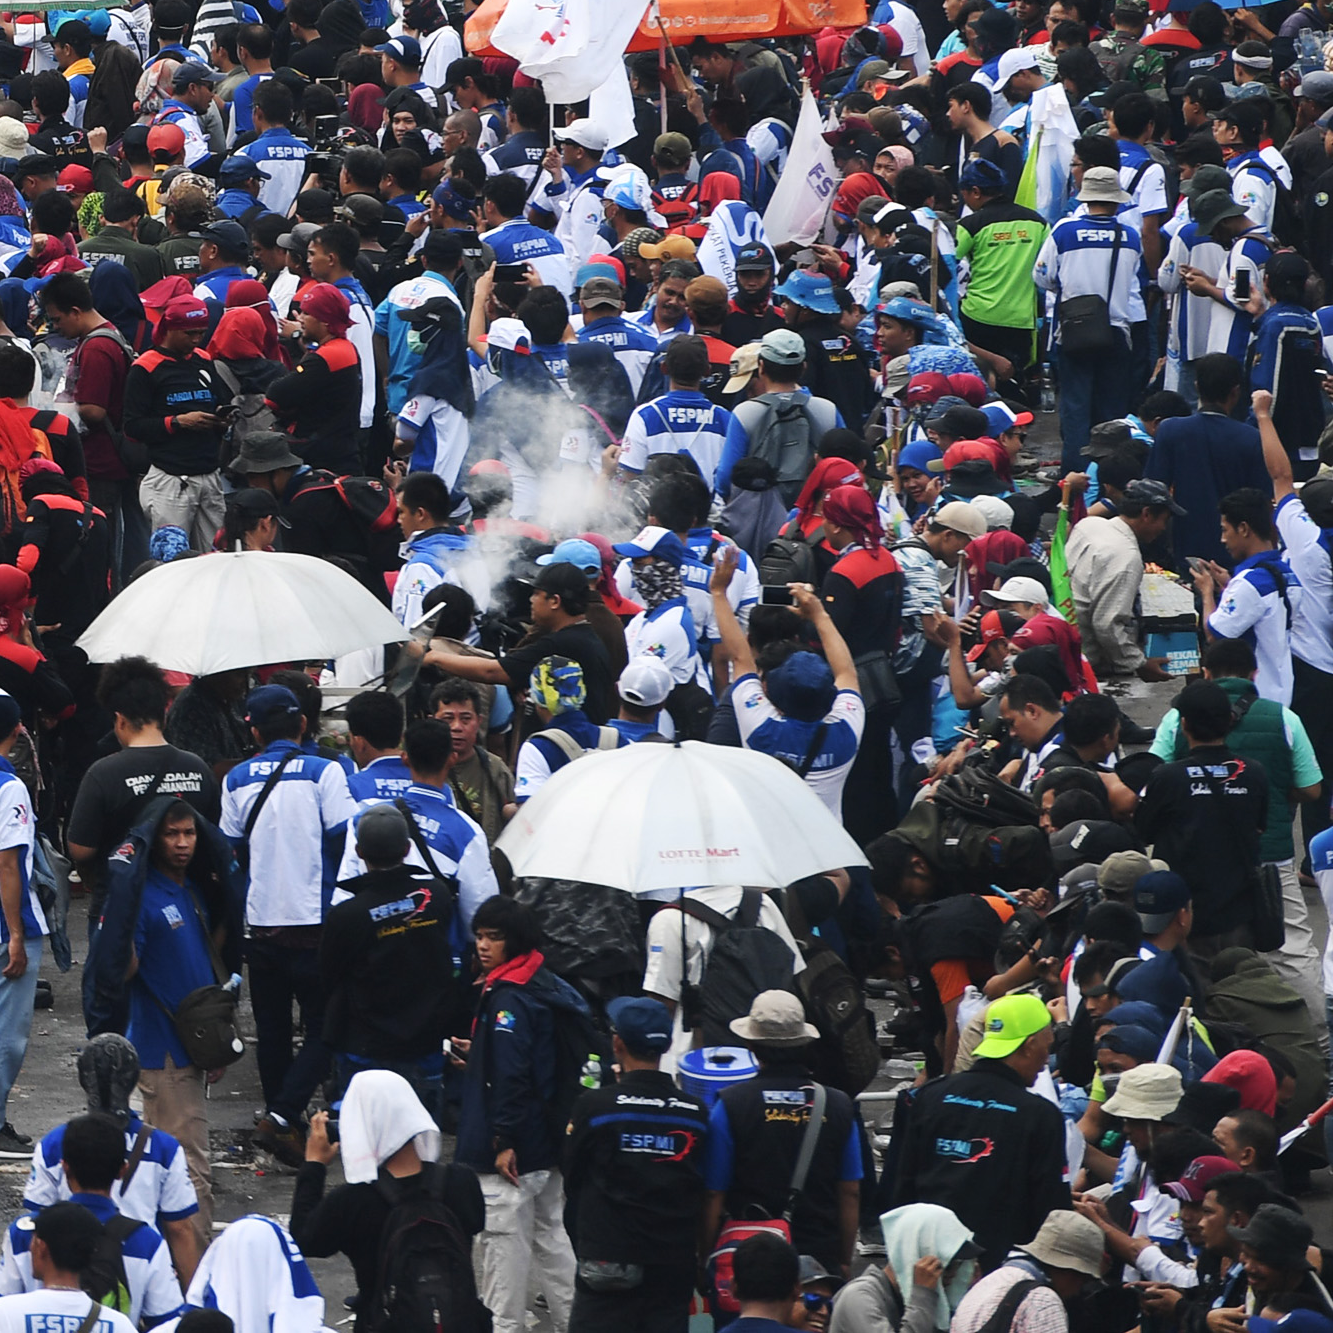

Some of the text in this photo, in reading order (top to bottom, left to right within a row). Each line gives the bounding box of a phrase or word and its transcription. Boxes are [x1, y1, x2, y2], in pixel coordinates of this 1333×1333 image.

[512, 237, 549, 254] FSPMI
[658, 847, 741, 859] LOTTE Mart
[620, 1133, 675, 1151] FSPMI
[936, 1137, 972, 1155] FSPMI
